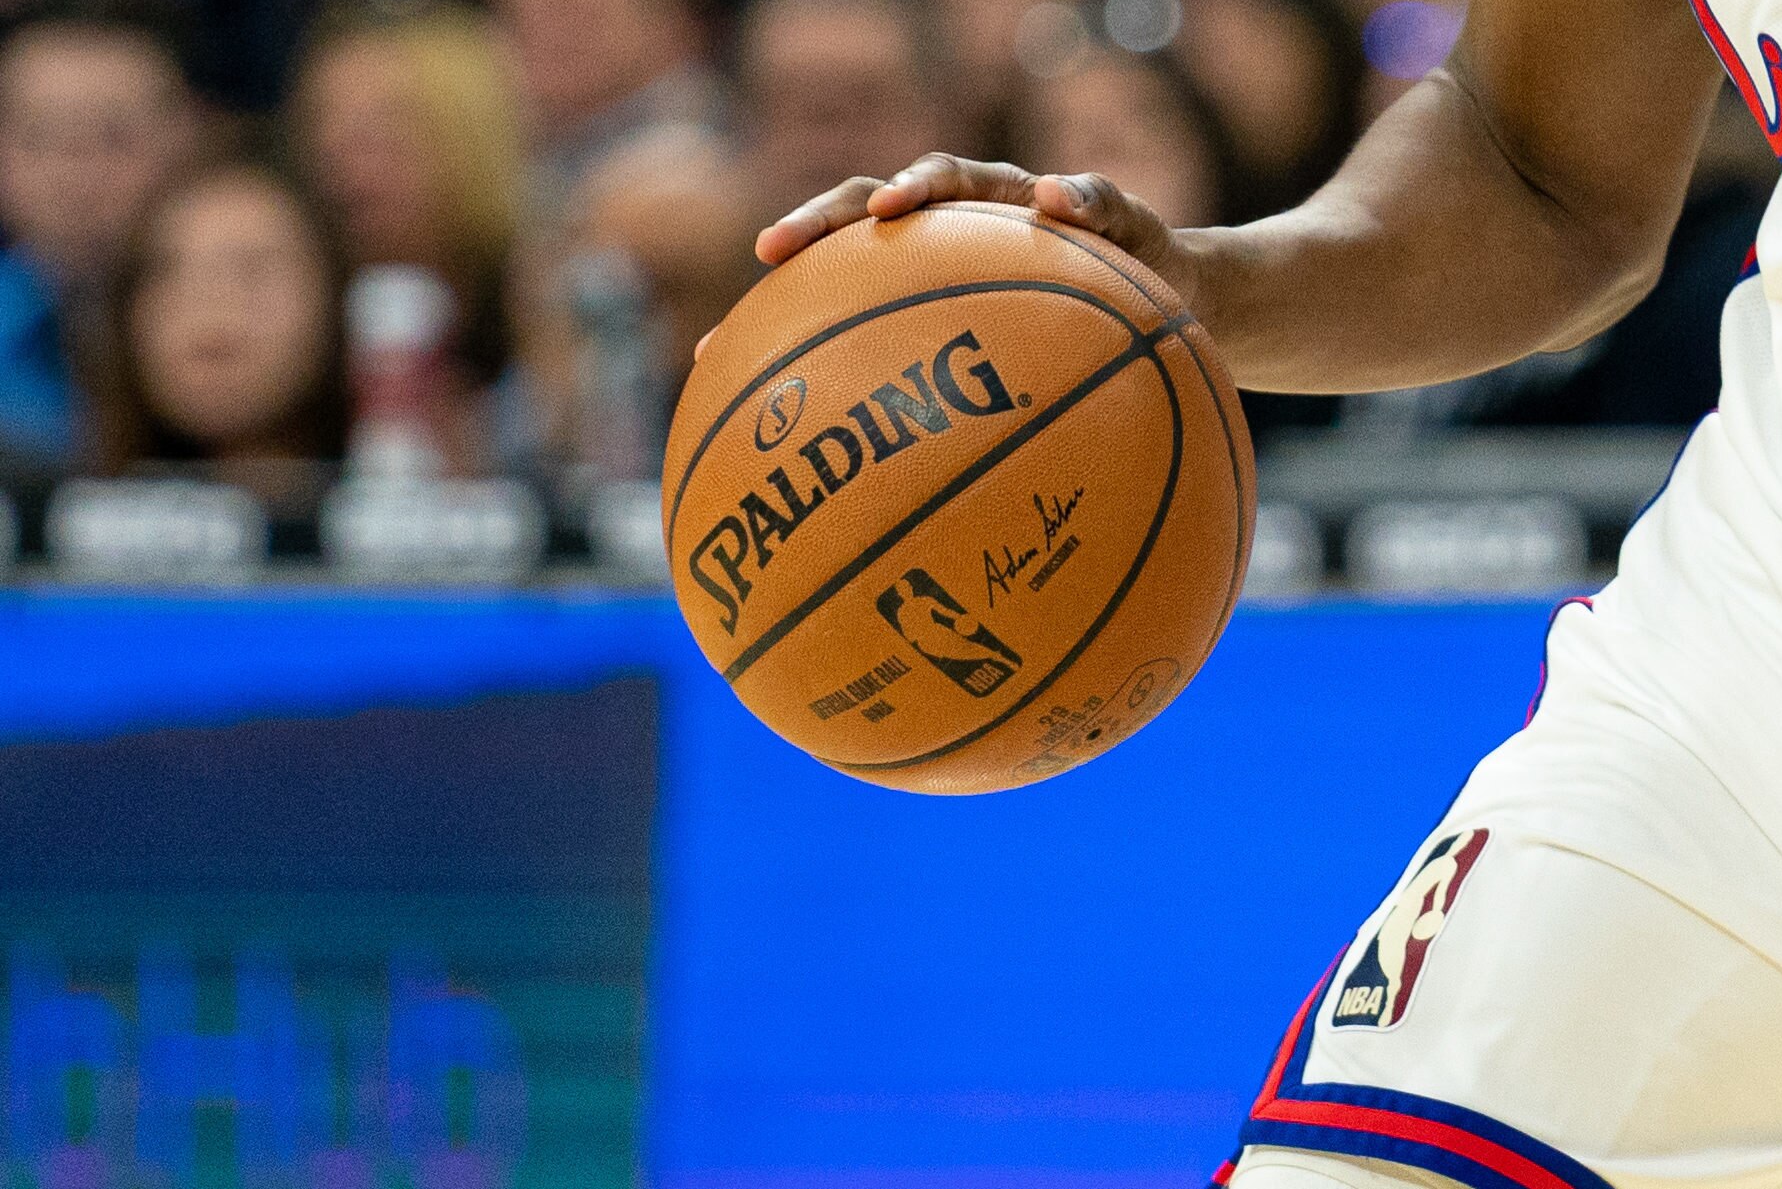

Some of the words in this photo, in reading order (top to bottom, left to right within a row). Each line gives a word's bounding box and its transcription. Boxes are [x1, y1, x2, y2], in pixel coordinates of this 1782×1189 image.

[688, 329, 1016, 637] SPALDING
[963, 662, 1005, 694] NBA
[1335, 985, 1385, 1018] NBA
